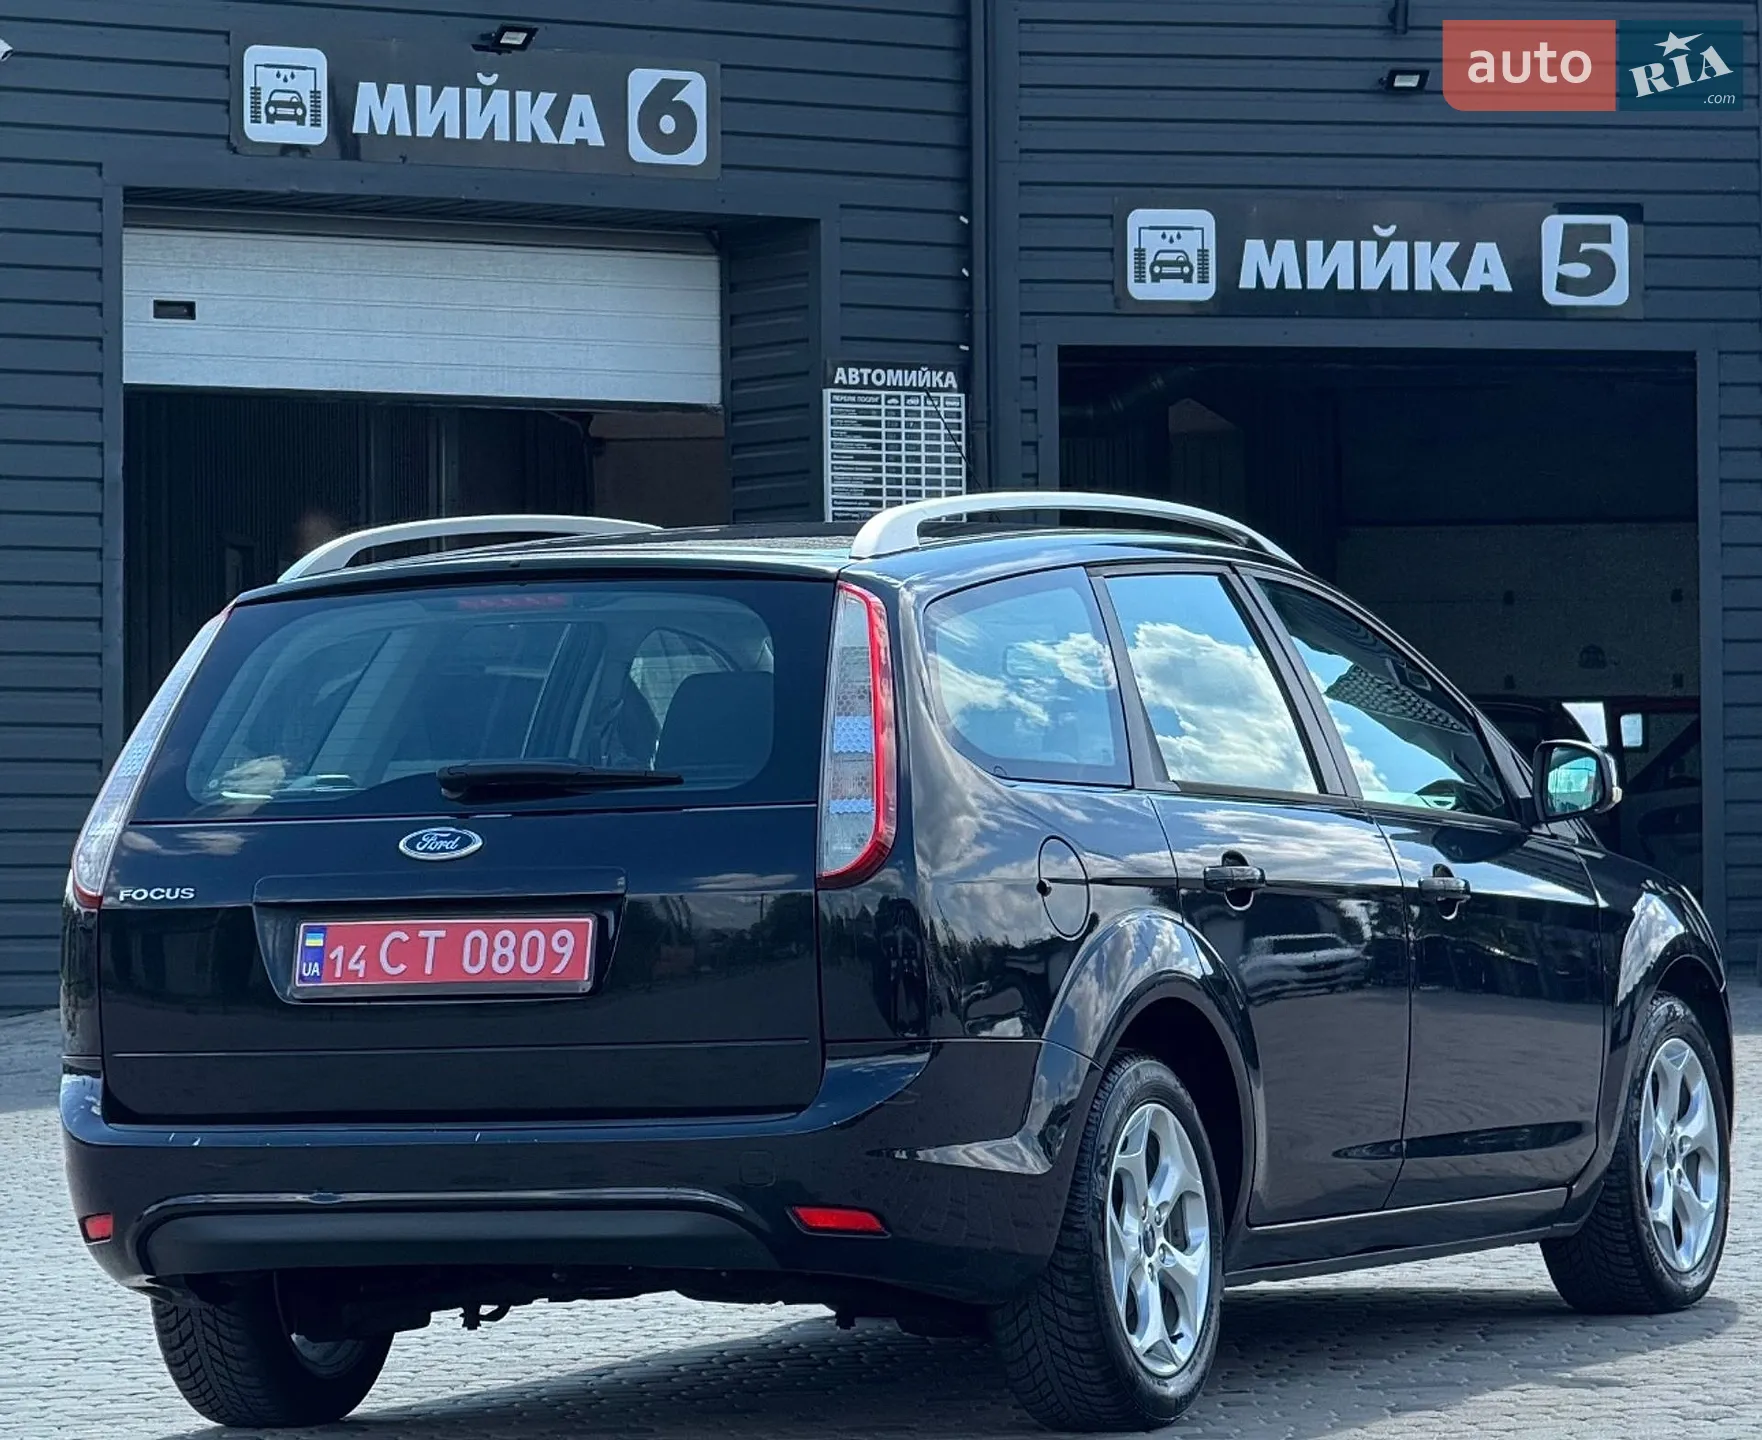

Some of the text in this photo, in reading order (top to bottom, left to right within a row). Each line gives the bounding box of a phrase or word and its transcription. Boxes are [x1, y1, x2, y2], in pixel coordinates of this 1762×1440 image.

[352, 72, 698, 156] МИЙКА 6
[1238, 222, 1617, 298] МИЙКА 5
[834, 367, 958, 389] АВТОМИЙКА
[415, 830, 459, 852] Ford
[118, 887, 195, 901] FOCUS
[329, 945, 367, 978] 14
[462, 928, 575, 975] 0809
[302, 962, 321, 977] UA
